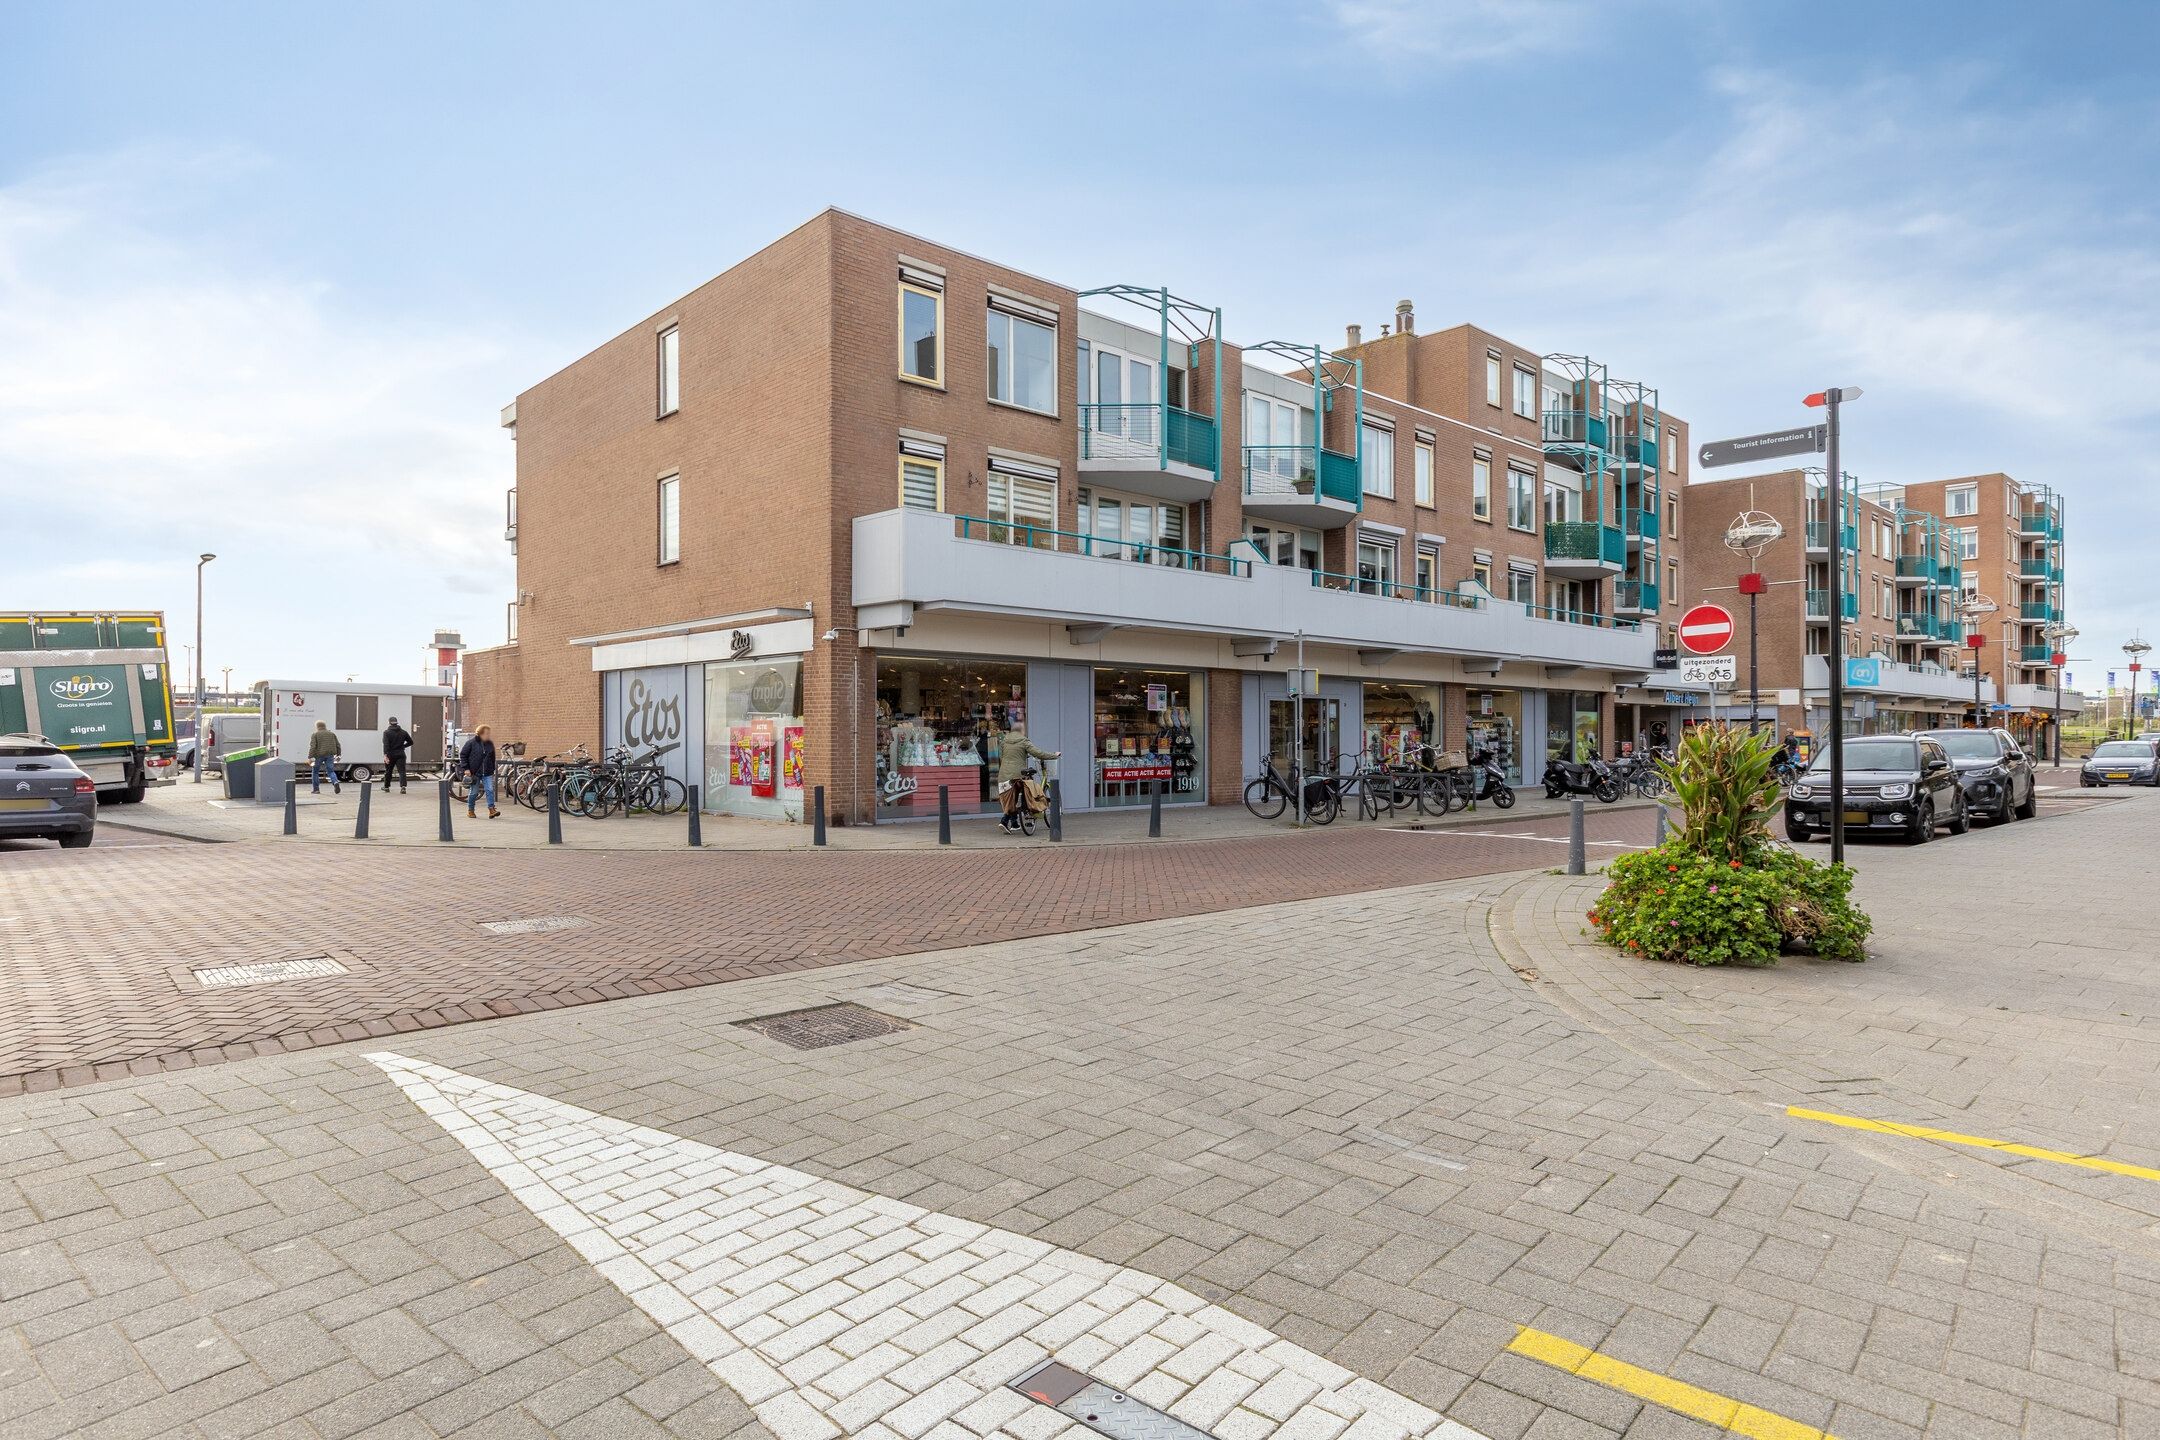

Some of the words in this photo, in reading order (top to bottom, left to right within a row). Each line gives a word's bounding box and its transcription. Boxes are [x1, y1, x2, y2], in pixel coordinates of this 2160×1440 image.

[1733, 440, 1759, 449] Tourist
[1760, 433, 1805, 445] Information
[731, 630, 751, 651] Etos
[1684, 658, 1732, 666] uitgezonderd
[55, 680, 110, 694] Sligro
[1665, 691, 1684, 704] Albert
[625, 679, 681, 747] Etos
[70, 725, 106, 735] sligro.nl
[709, 766, 726, 786] Etos
[884, 771, 918, 794] Etos
[1177, 776, 1200, 791] 1919
